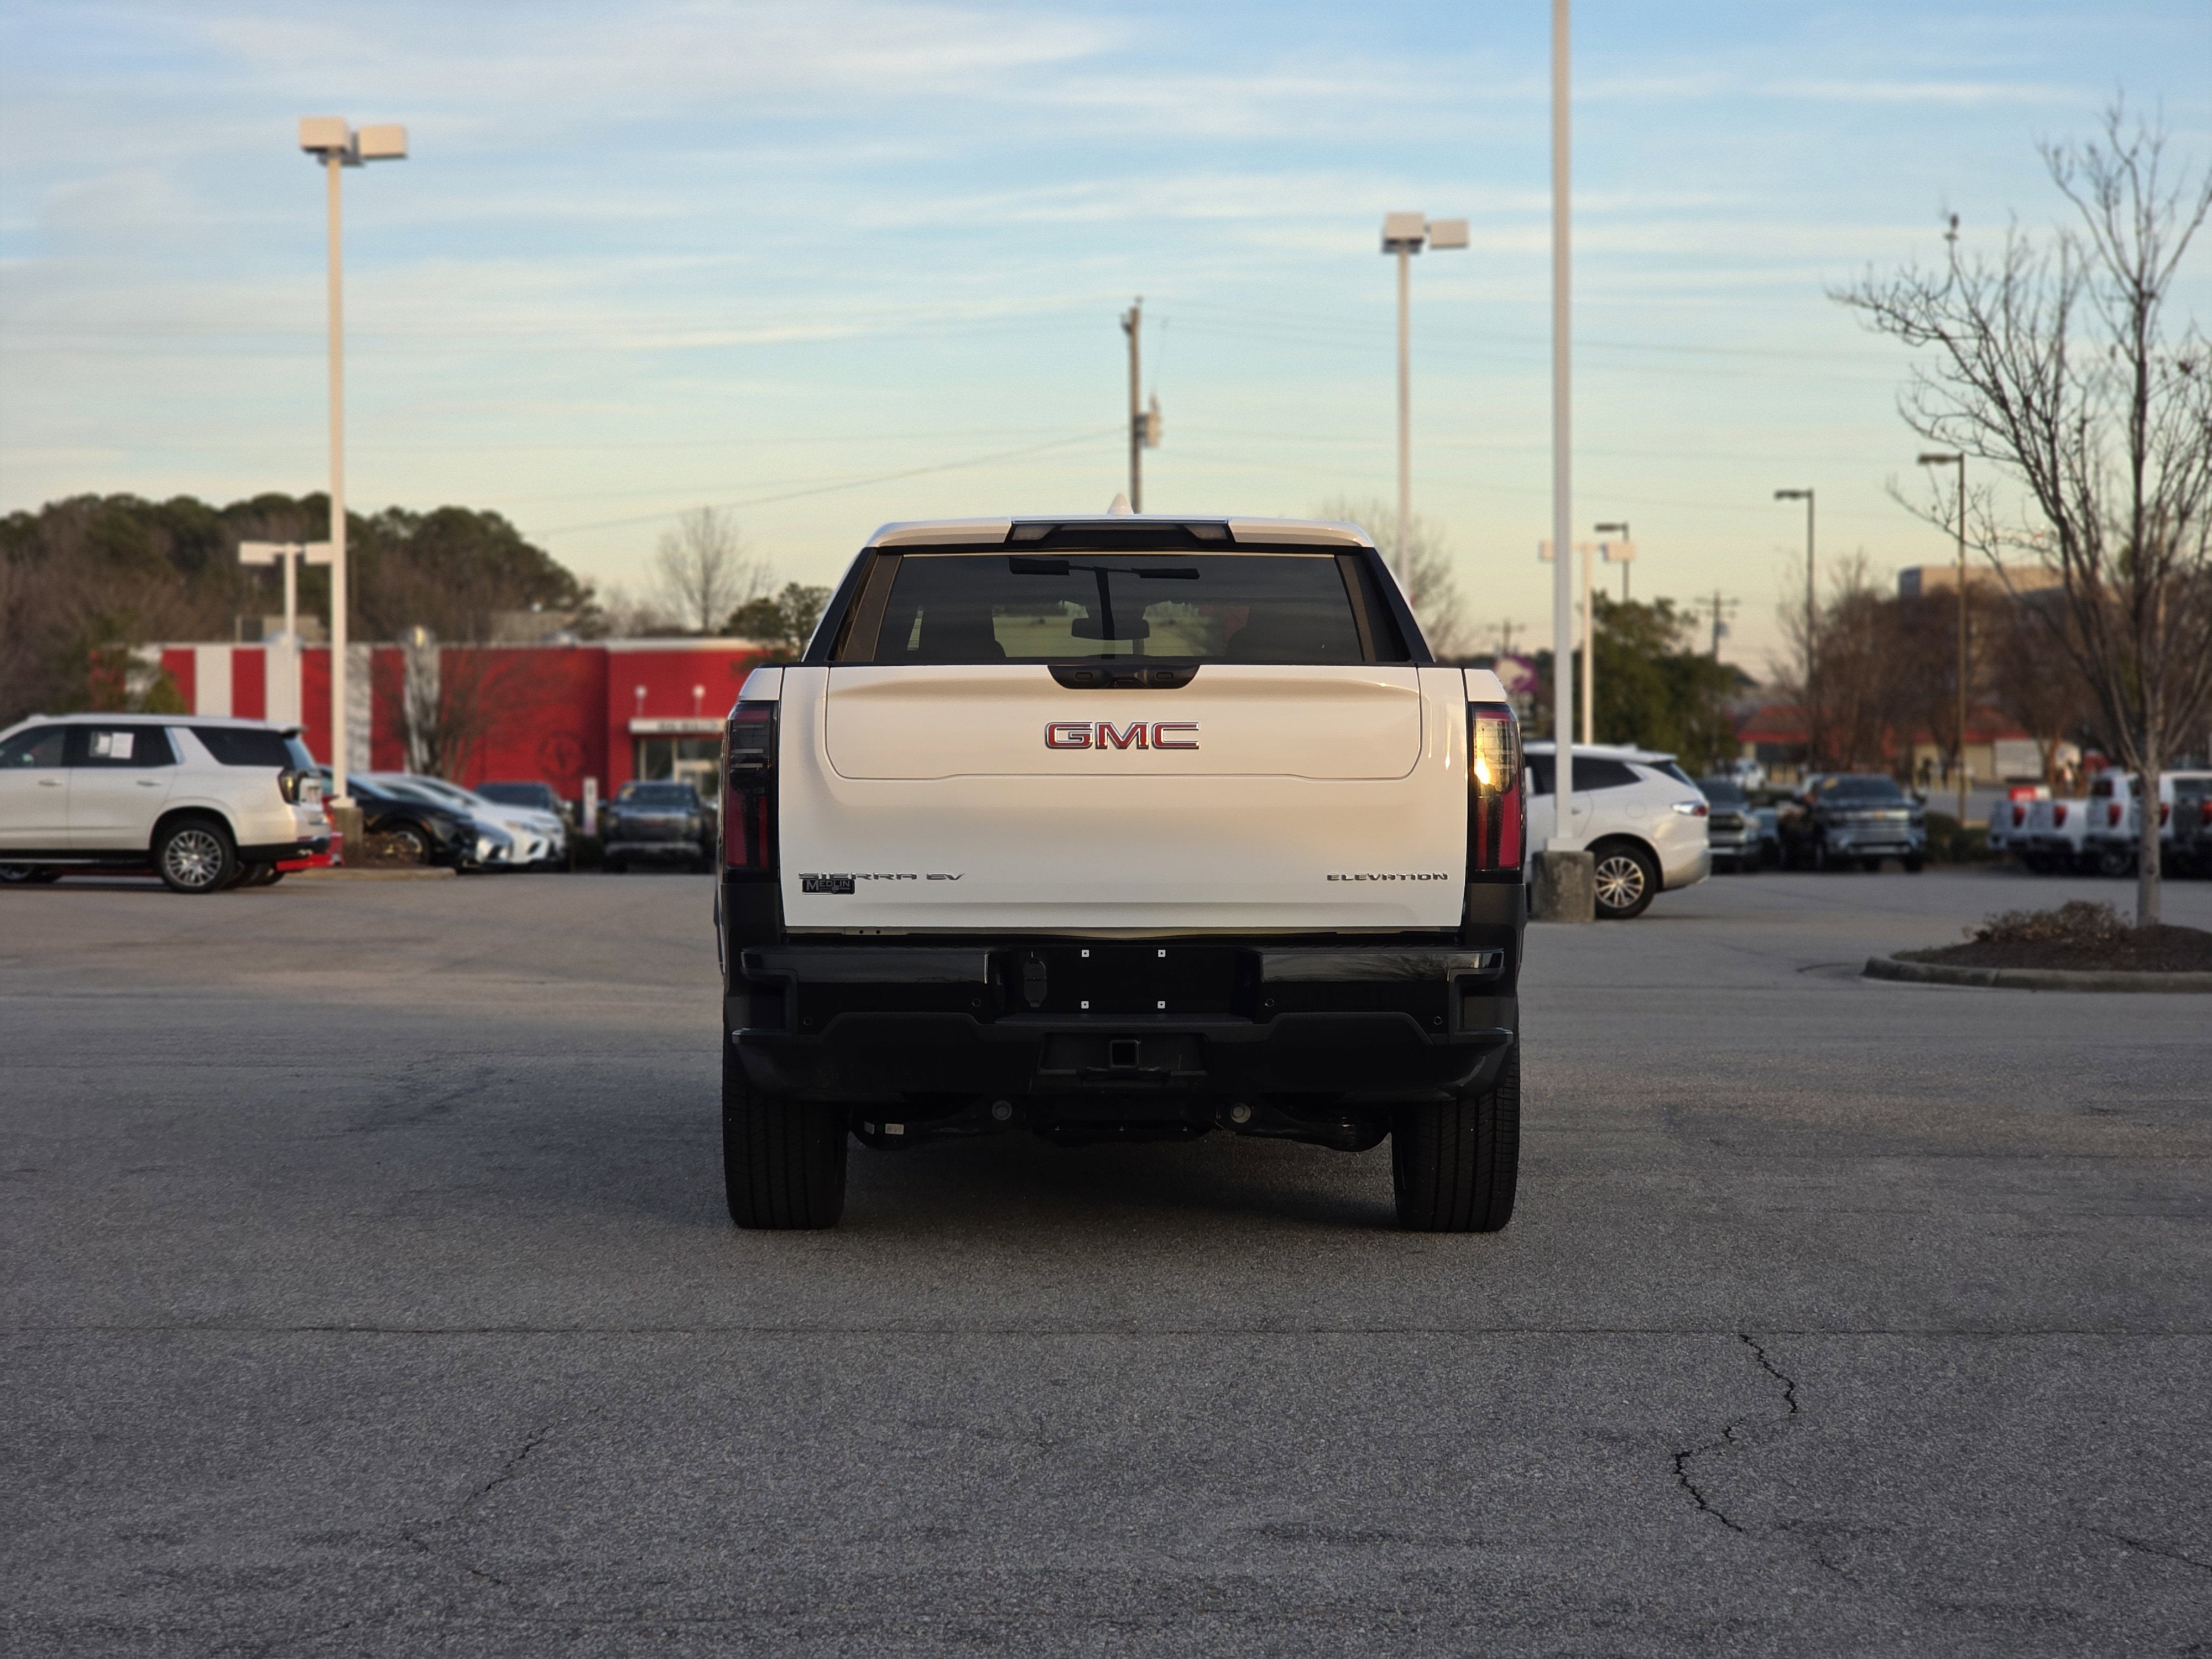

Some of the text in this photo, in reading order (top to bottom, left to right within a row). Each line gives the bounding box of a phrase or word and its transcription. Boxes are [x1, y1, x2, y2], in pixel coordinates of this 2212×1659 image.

[1045, 722, 1199, 749] GMC
[799, 872, 965, 880] SIERRA EV
[806, 880, 850, 891] MEDLIN
